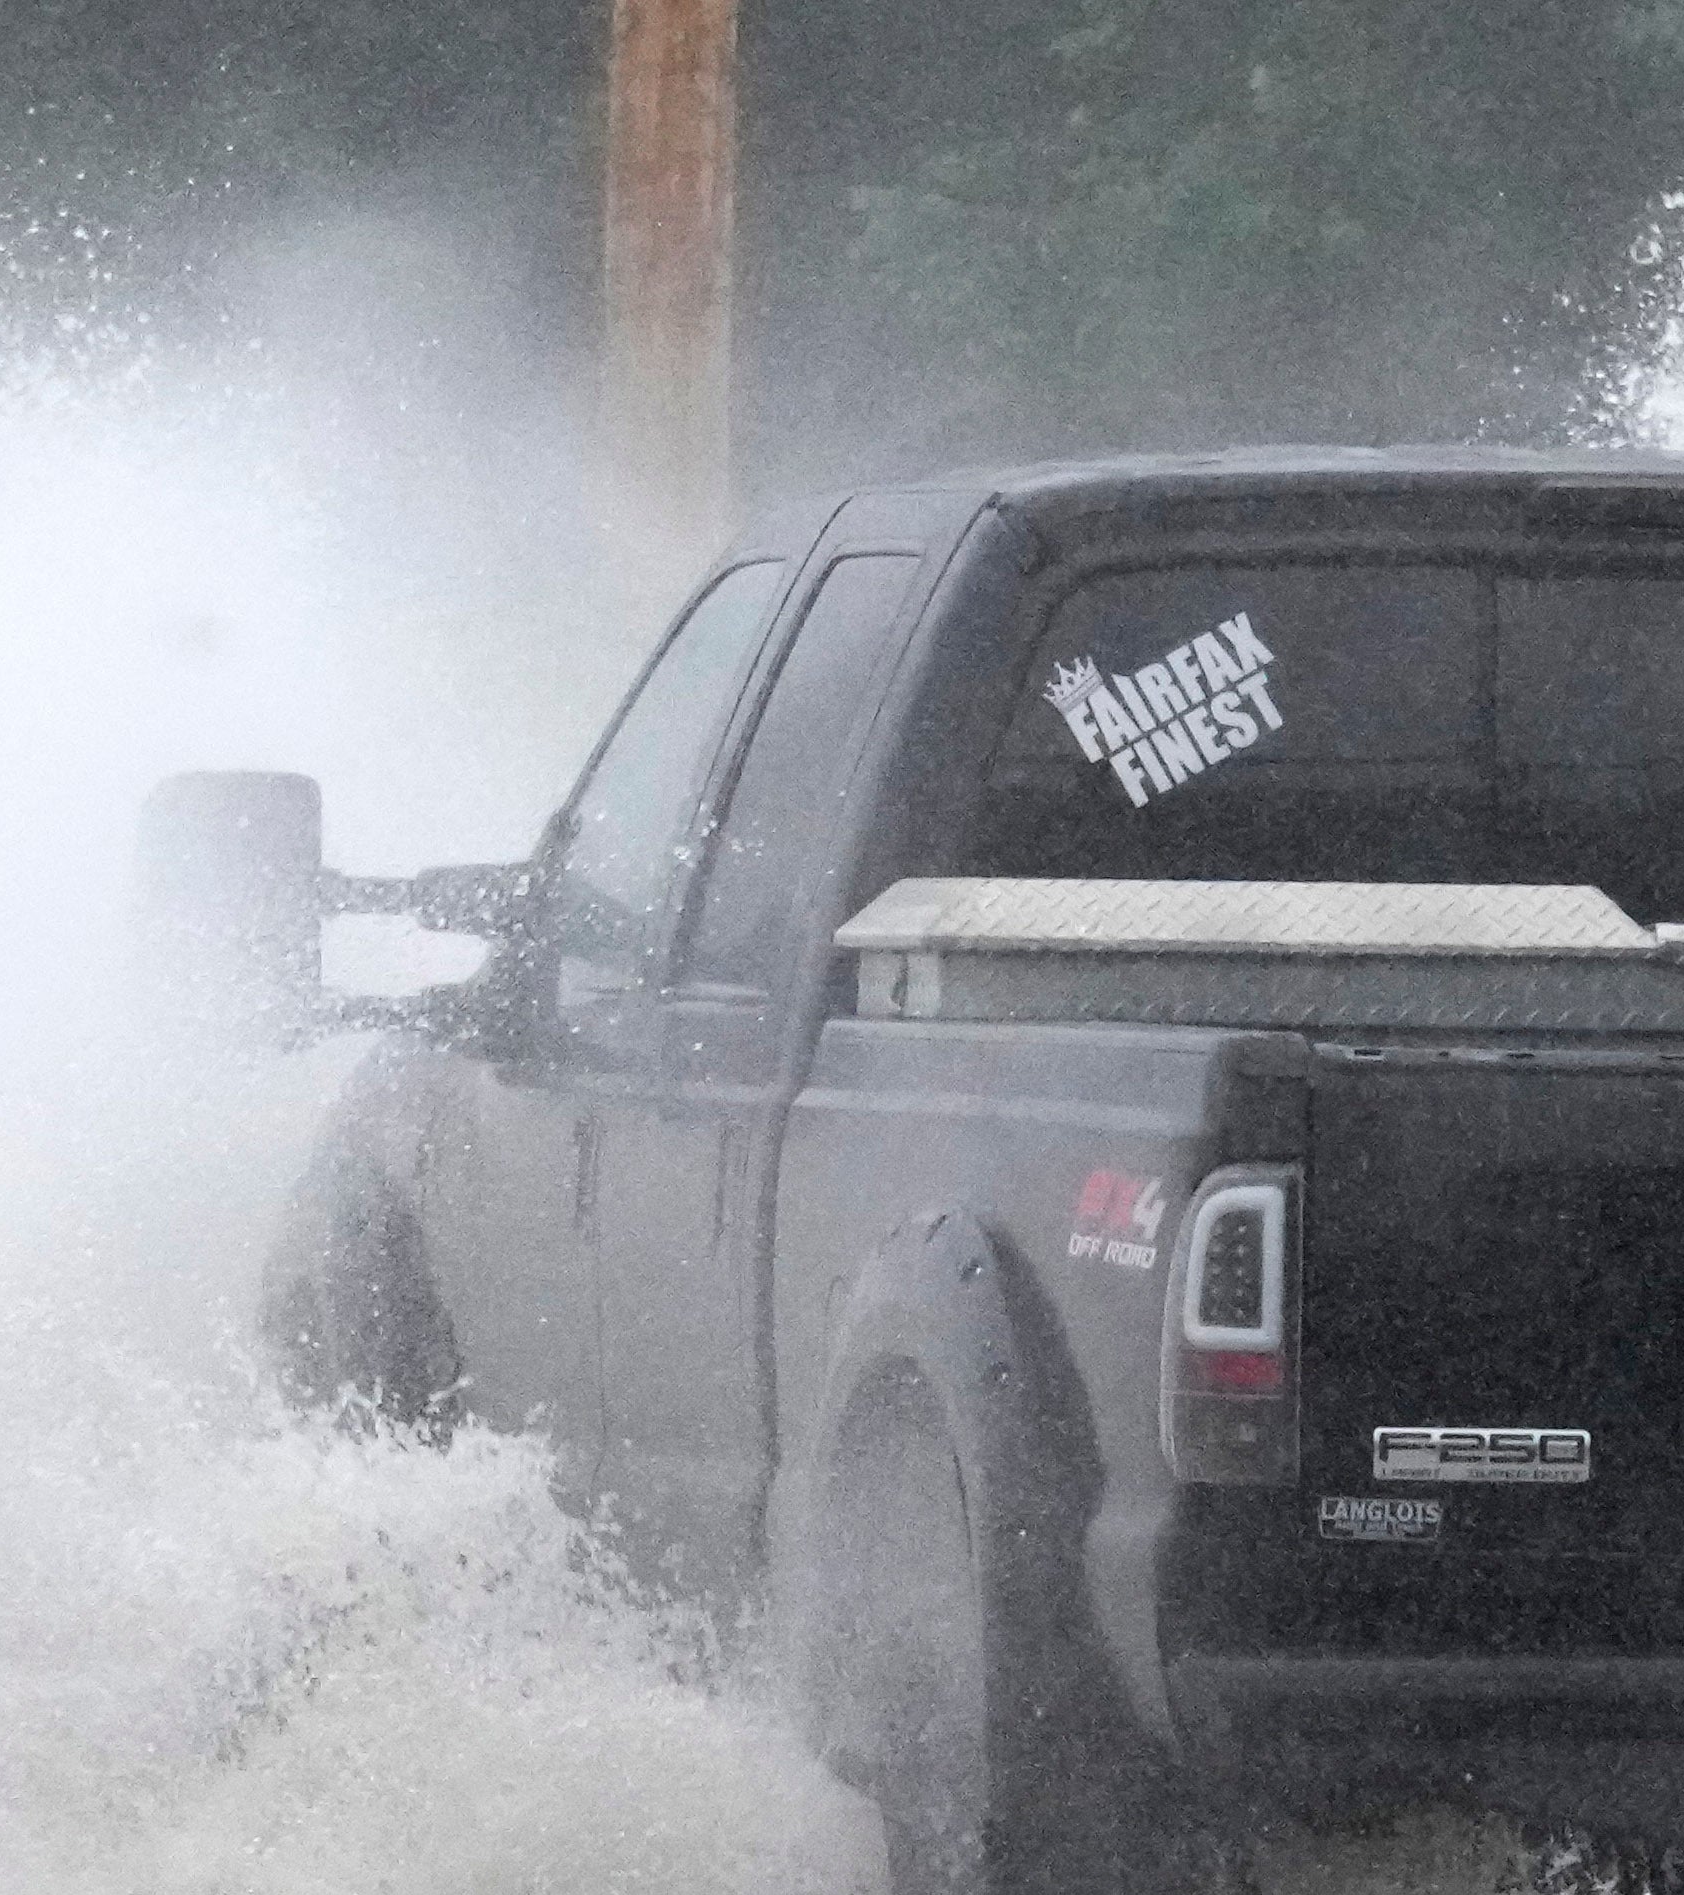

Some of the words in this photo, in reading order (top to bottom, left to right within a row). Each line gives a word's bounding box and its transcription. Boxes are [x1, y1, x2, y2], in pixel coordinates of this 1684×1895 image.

[1065, 611, 1275, 763] FAIRFAX
[1109, 671, 1283, 808] FINEST
[1321, 1498, 1441, 1523] LANGLOIS
